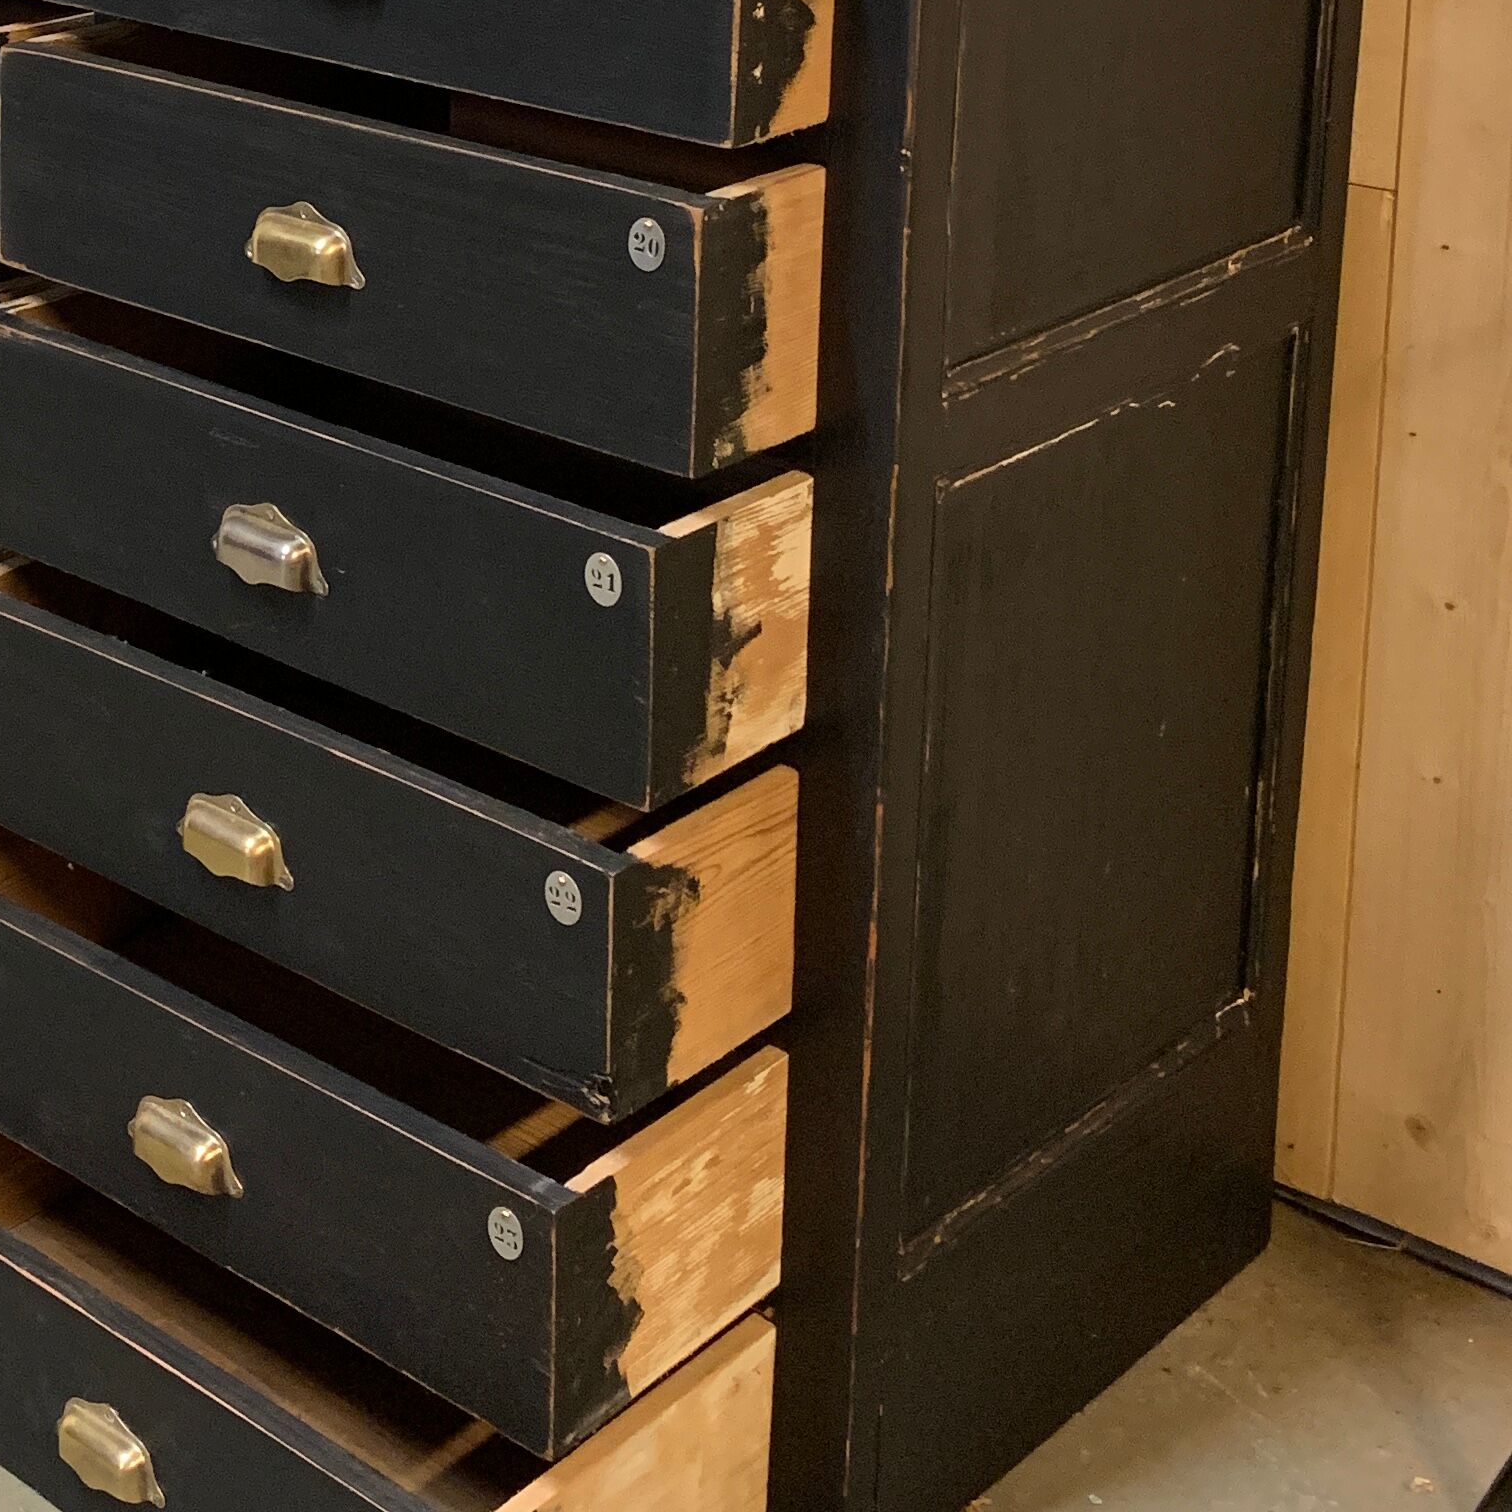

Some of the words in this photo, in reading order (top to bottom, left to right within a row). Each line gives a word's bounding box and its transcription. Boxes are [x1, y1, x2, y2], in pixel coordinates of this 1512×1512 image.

[634, 233, 658, 258] 20
[591, 567, 615, 592] 21
[549, 886, 576, 911] 22
[494, 1223, 518, 1249] 23
